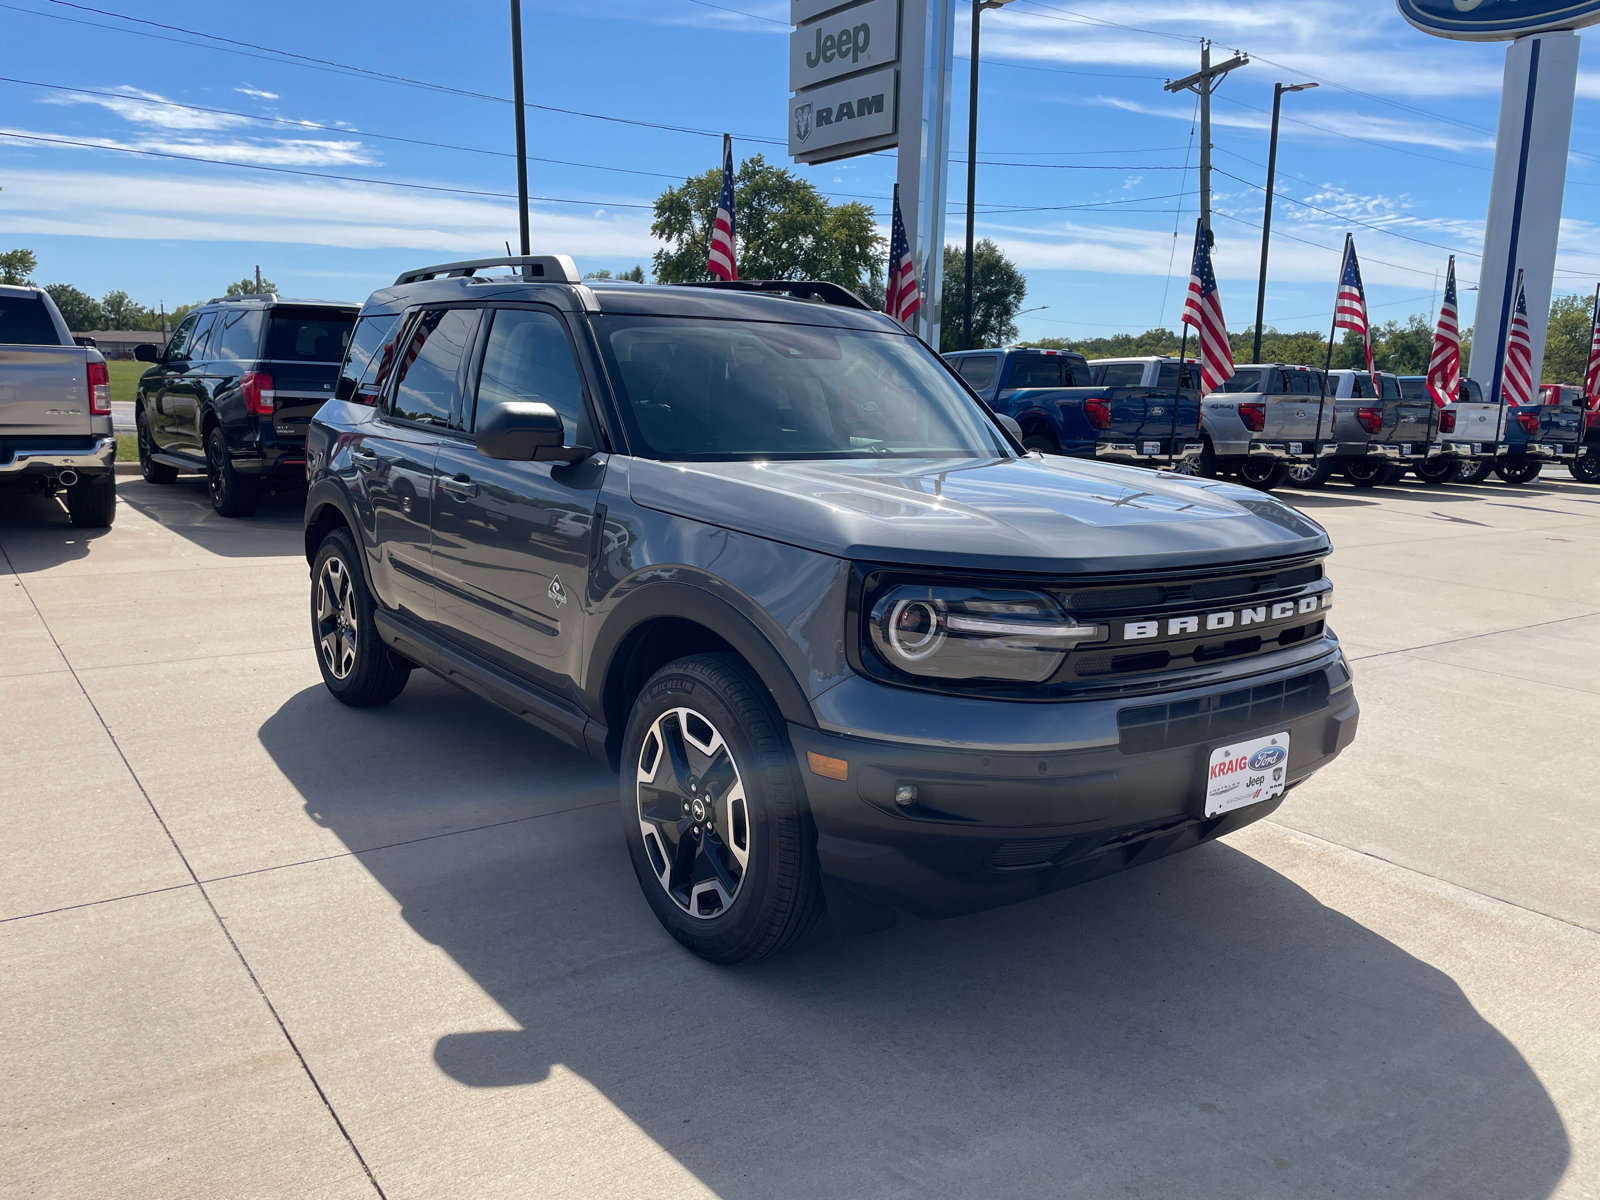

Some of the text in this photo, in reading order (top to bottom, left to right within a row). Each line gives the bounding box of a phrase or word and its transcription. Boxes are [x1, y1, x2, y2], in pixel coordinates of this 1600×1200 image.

[806, 23, 870, 68] Jeep
[816, 93, 884, 127] RAM
[1123, 596, 1317, 640] BRONCO
[652, 680, 692, 693] MICHELIN
[1210, 751, 1278, 779] KRAIG Ford
[1246, 775, 1265, 788] Jeep
